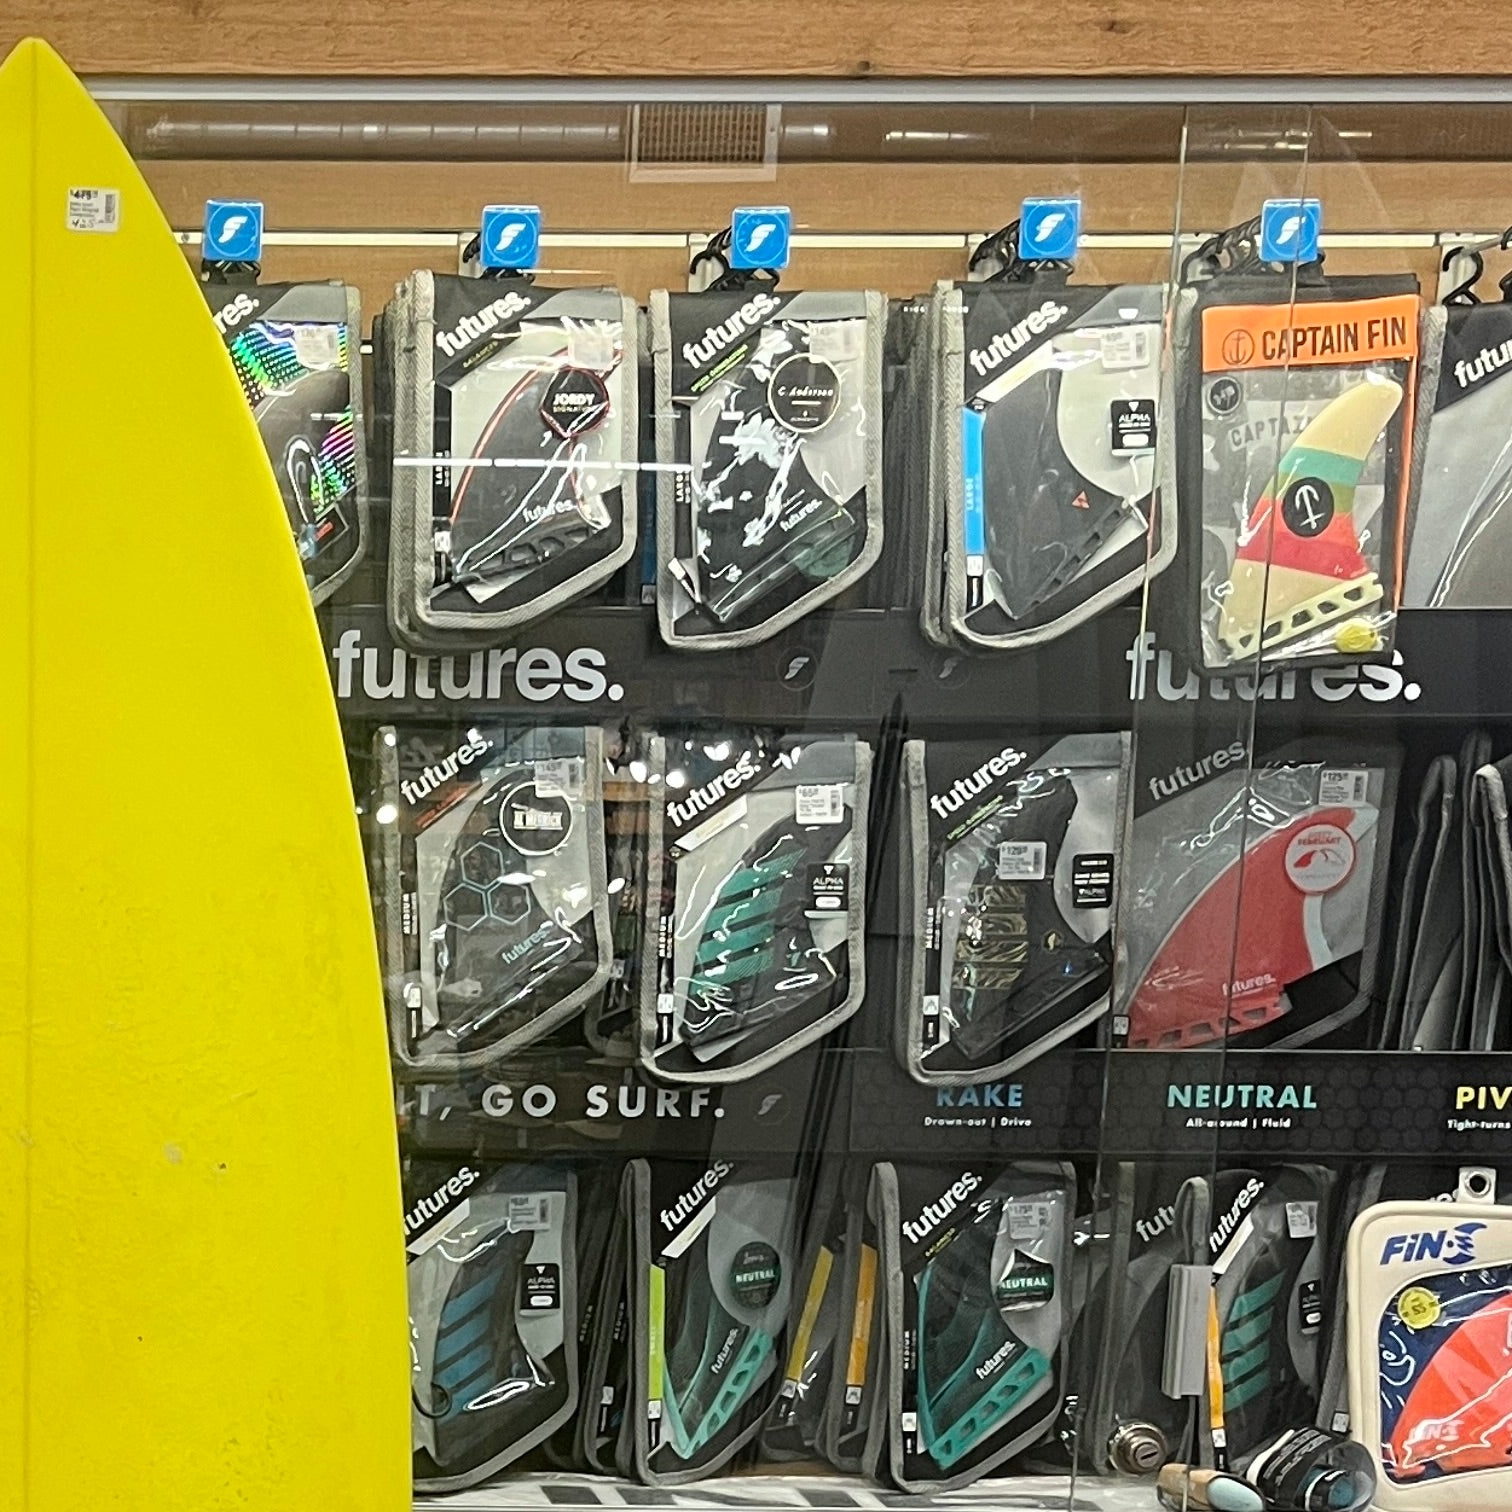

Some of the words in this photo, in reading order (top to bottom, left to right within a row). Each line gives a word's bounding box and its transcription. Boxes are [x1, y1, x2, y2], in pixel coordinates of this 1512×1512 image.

[435, 291, 531, 357] futures.
[683, 293, 781, 369] futures.
[969, 301, 1068, 376] futures.
[1262, 322, 1358, 361] CAPTAIN
[1367, 316, 1406, 350] FIN
[1119, 413, 1150, 423] ALPHA
[333, 629, 625, 701] futures.
[400, 731, 494, 805] futures.
[667, 757, 761, 827] futures.
[930, 748, 1027, 820] futures.
[813, 876, 844, 886] ALPHA
[482, 1085, 556, 1119] GO
[587, 1085, 725, 1119] SURF.
[937, 1083, 1024, 1107] RAKE
[1000, 1116, 1032, 1127] Drive
[1167, 1084, 1318, 1109] NEUTRAL
[1455, 1086, 1512, 1110] PIV
[660, 1159, 735, 1232] futures.
[903, 1171, 983, 1244] futures.
[735, 1270, 775, 1284] NEUTRAL
